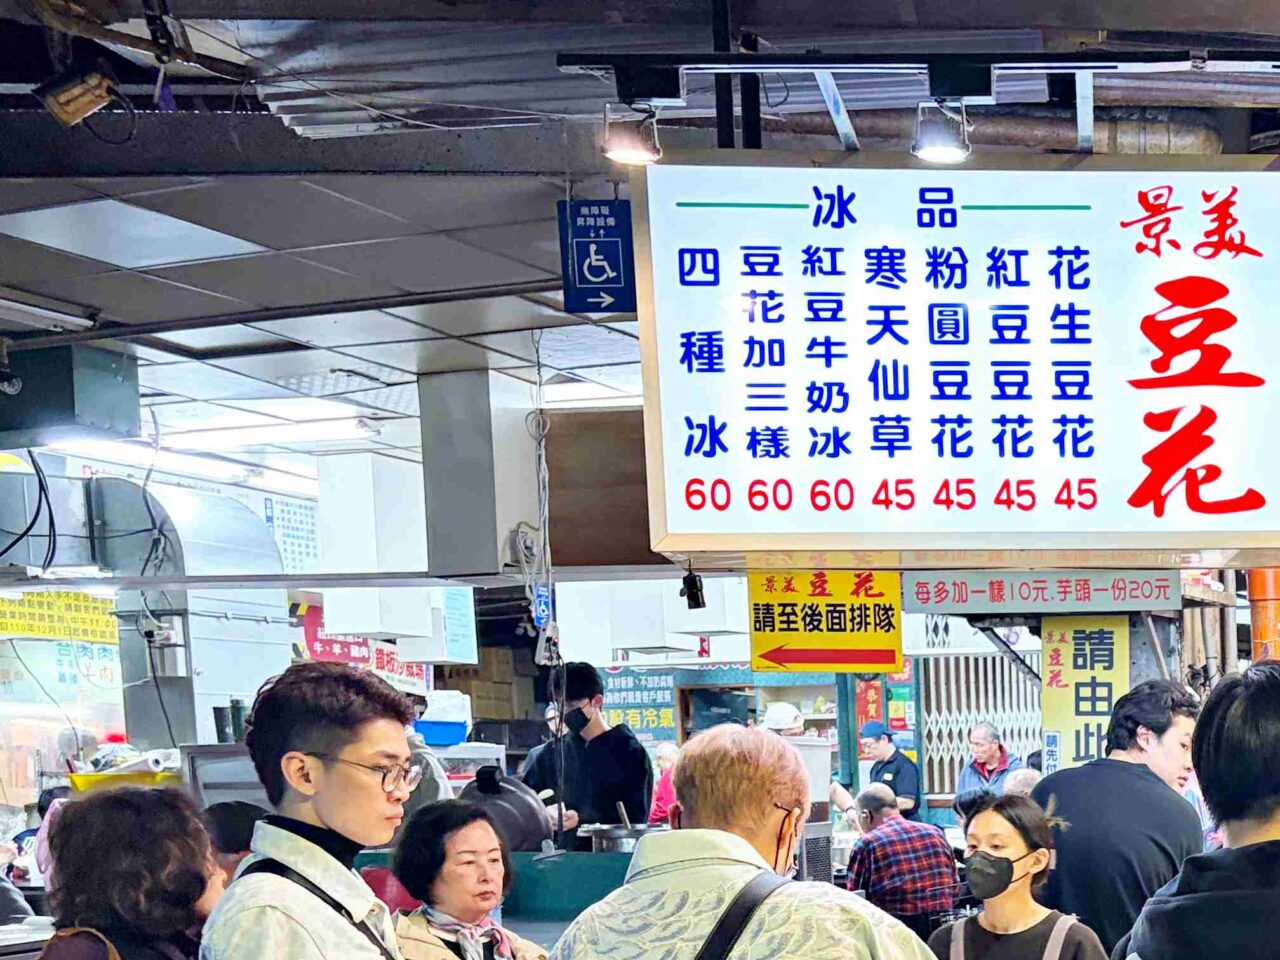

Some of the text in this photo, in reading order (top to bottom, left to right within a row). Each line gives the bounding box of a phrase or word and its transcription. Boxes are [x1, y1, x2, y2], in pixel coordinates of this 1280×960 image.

[812, 184, 957, 229] 冰品
[1120, 185, 1264, 260] 景美
[678, 248, 729, 458] 四種冰
[740, 245, 789, 458] 豆花加三樣
[802, 244, 852, 458] 紅豆牛奶冰
[864, 245, 912, 458] 寒天仙草
[925, 246, 974, 458] 粉圓豆花
[986, 246, 1034, 458] 紅豆豆花
[1047, 245, 1095, 458] 花生豆花
[1127, 276, 1266, 518] 豆花
[685, 478, 1097, 511] 60 60 60 45 45 45 45
[761, 571, 886, 598] 景美豆花
[752, 602, 897, 633] 請至後面排隊
[1047, 647, 1069, 689] 豆花
[1072, 628, 1115, 763] 請由此
